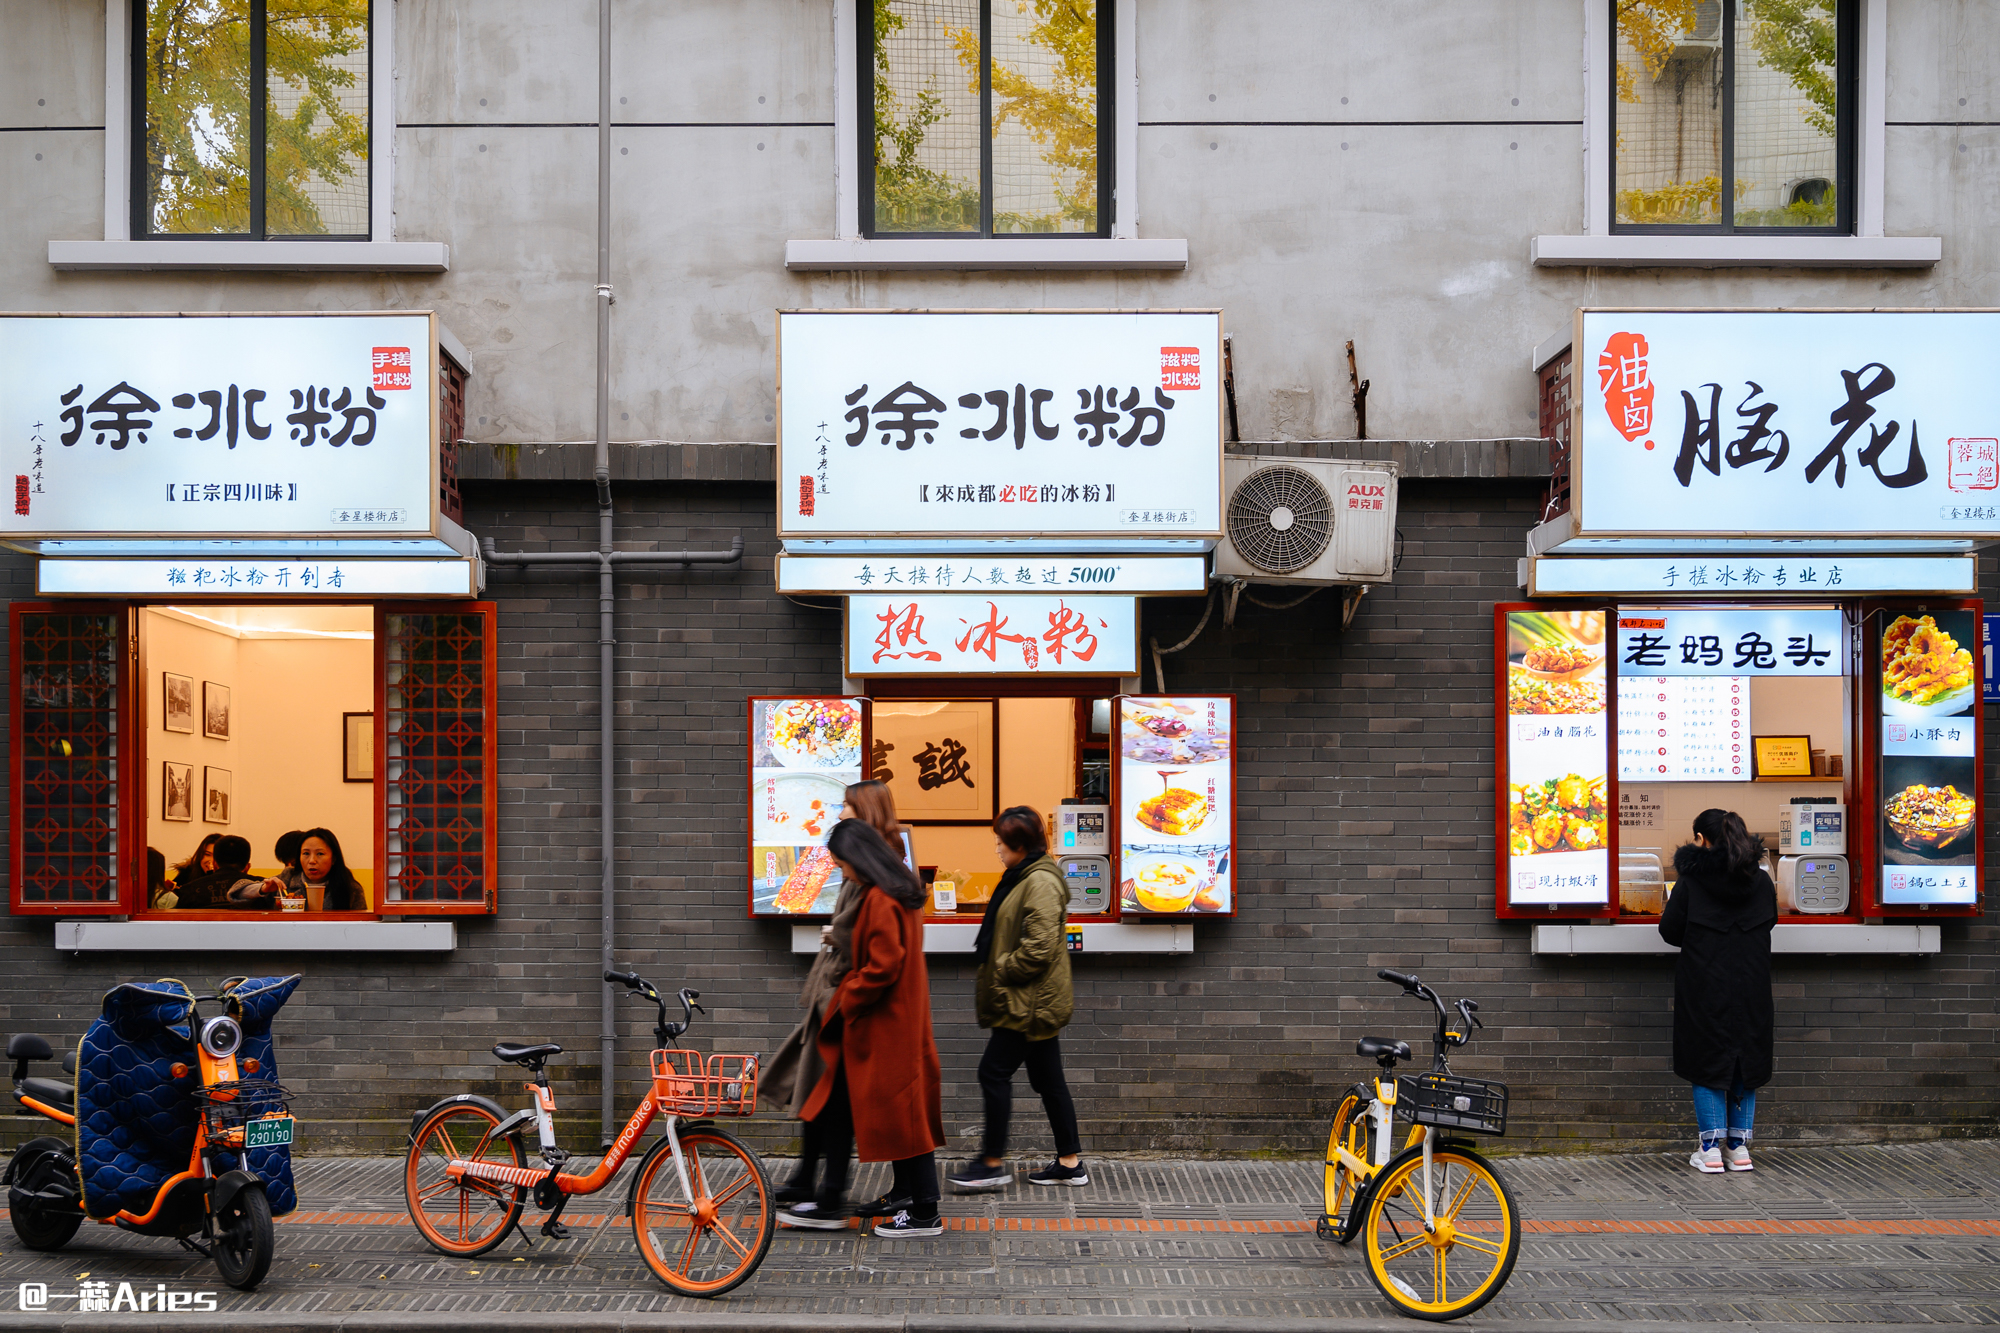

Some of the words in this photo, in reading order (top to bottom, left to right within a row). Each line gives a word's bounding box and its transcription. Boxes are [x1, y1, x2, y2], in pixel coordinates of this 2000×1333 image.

[1598, 343, 1651, 432] 油卤
[60, 381, 386, 450] 徐冰粉
[845, 381, 1175, 450] 徐冰粉
[1673, 362, 1929, 489] 脑花
[1955, 444, 1995, 462] 蓉城
[1347, 484, 1386, 497] AUX
[1348, 498, 1383, 510] 奥克斯
[1951, 506, 1996, 519] 奎星楼店
[339, 510, 399, 522] 奎星楼街店
[1128, 511, 1188, 522] 奎星楼街店
[167, 566, 346, 589] 糍粑冰粉开创者
[1662, 565, 1843, 587] 手搓冰粉专业店
[872, 599, 1108, 665] 热冰粉
[1624, 632, 1831, 669] 老妈兔头
[1909, 727, 1961, 741] 小酥肉
[1078, 818, 1103, 826] 充电宝
[617, 1100, 652, 1150] mobike
[250, 1129, 290, 1145] 290190
